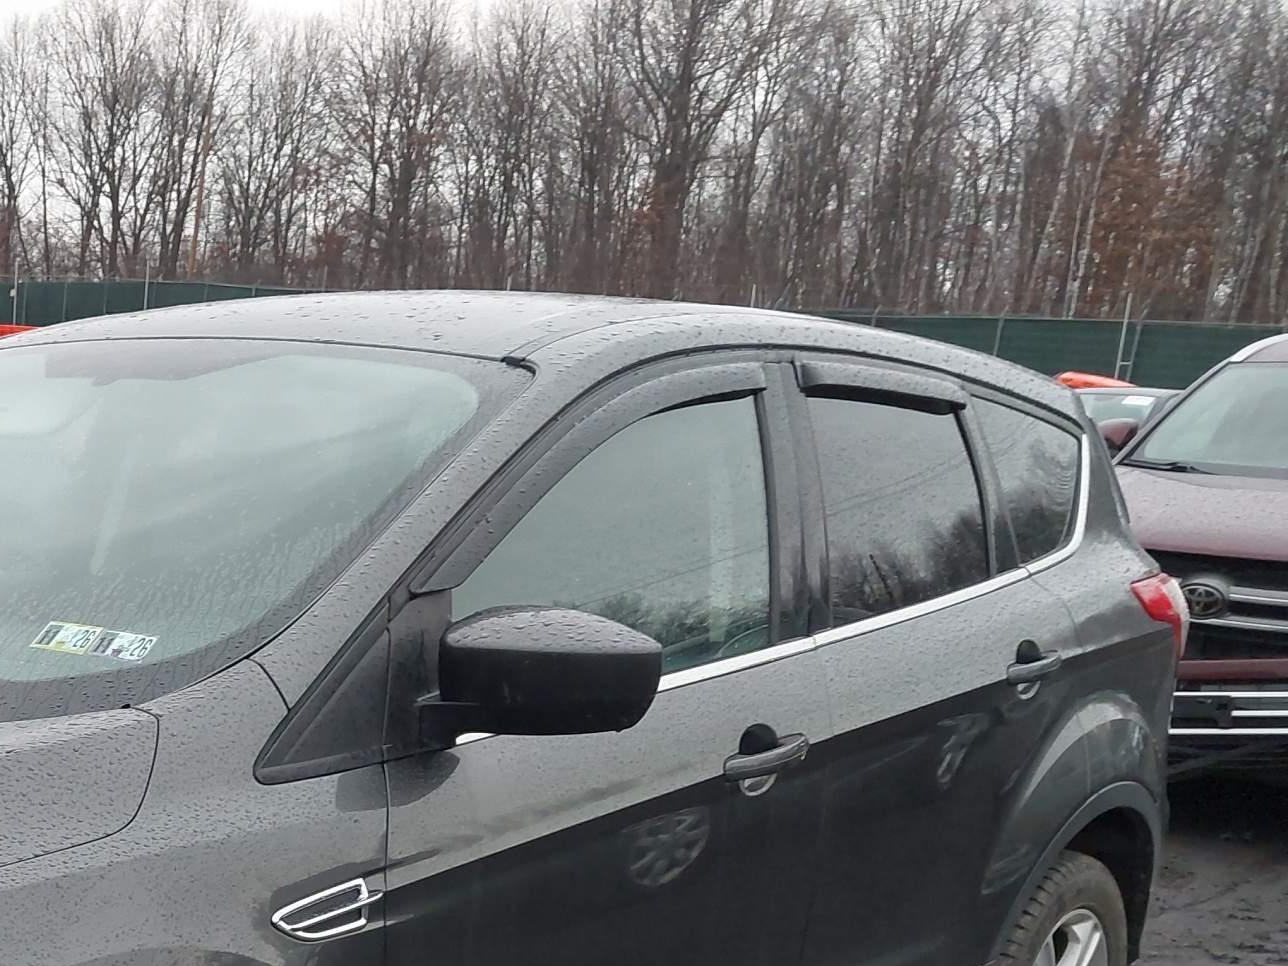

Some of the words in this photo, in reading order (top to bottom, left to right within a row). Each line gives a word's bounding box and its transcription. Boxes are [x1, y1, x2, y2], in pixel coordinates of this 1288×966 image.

[38, 628, 61, 646] 11
[73, 629, 97, 649] 26
[93, 636, 115, 654] 11
[130, 637, 154, 658] 26
